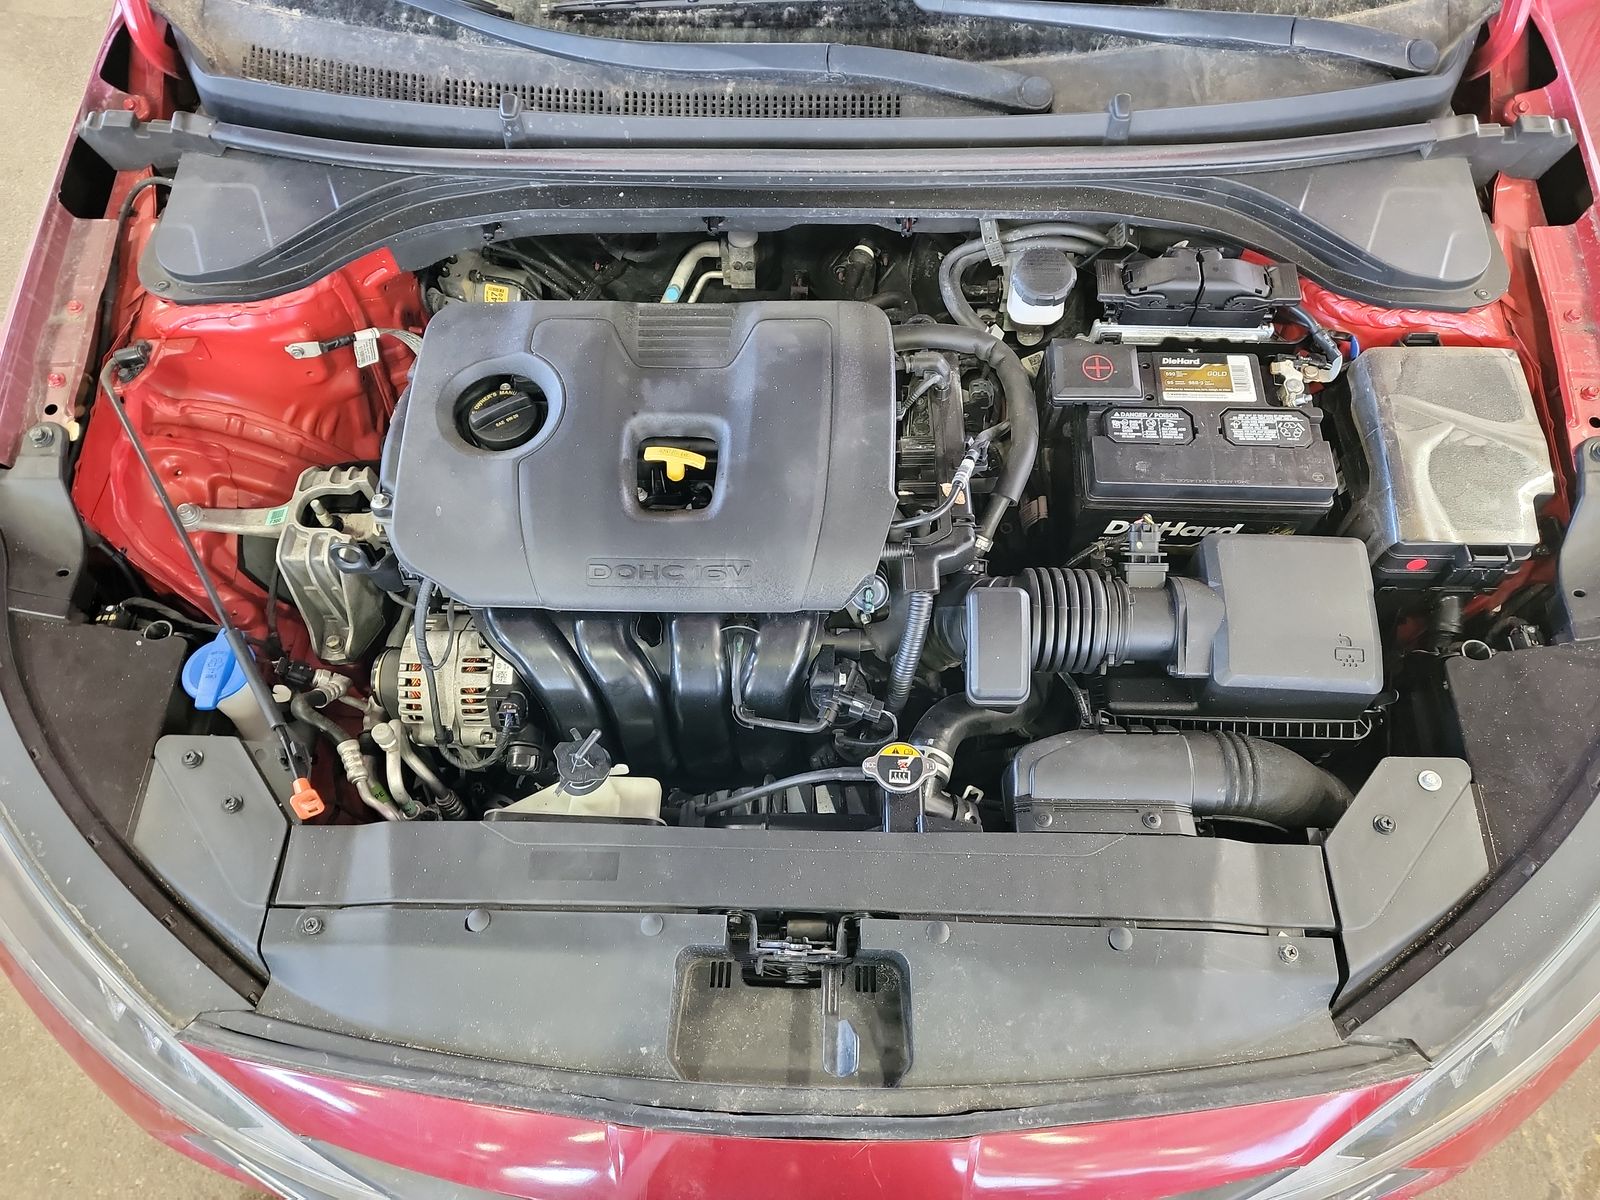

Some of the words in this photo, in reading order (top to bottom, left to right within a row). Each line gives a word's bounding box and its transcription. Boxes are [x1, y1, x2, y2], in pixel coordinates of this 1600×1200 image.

[1162, 357, 1200, 365] DieHard
[1103, 520, 1244, 537] DHard
[588, 563, 686, 580] DOHC
[696, 564, 751, 581] 16V
